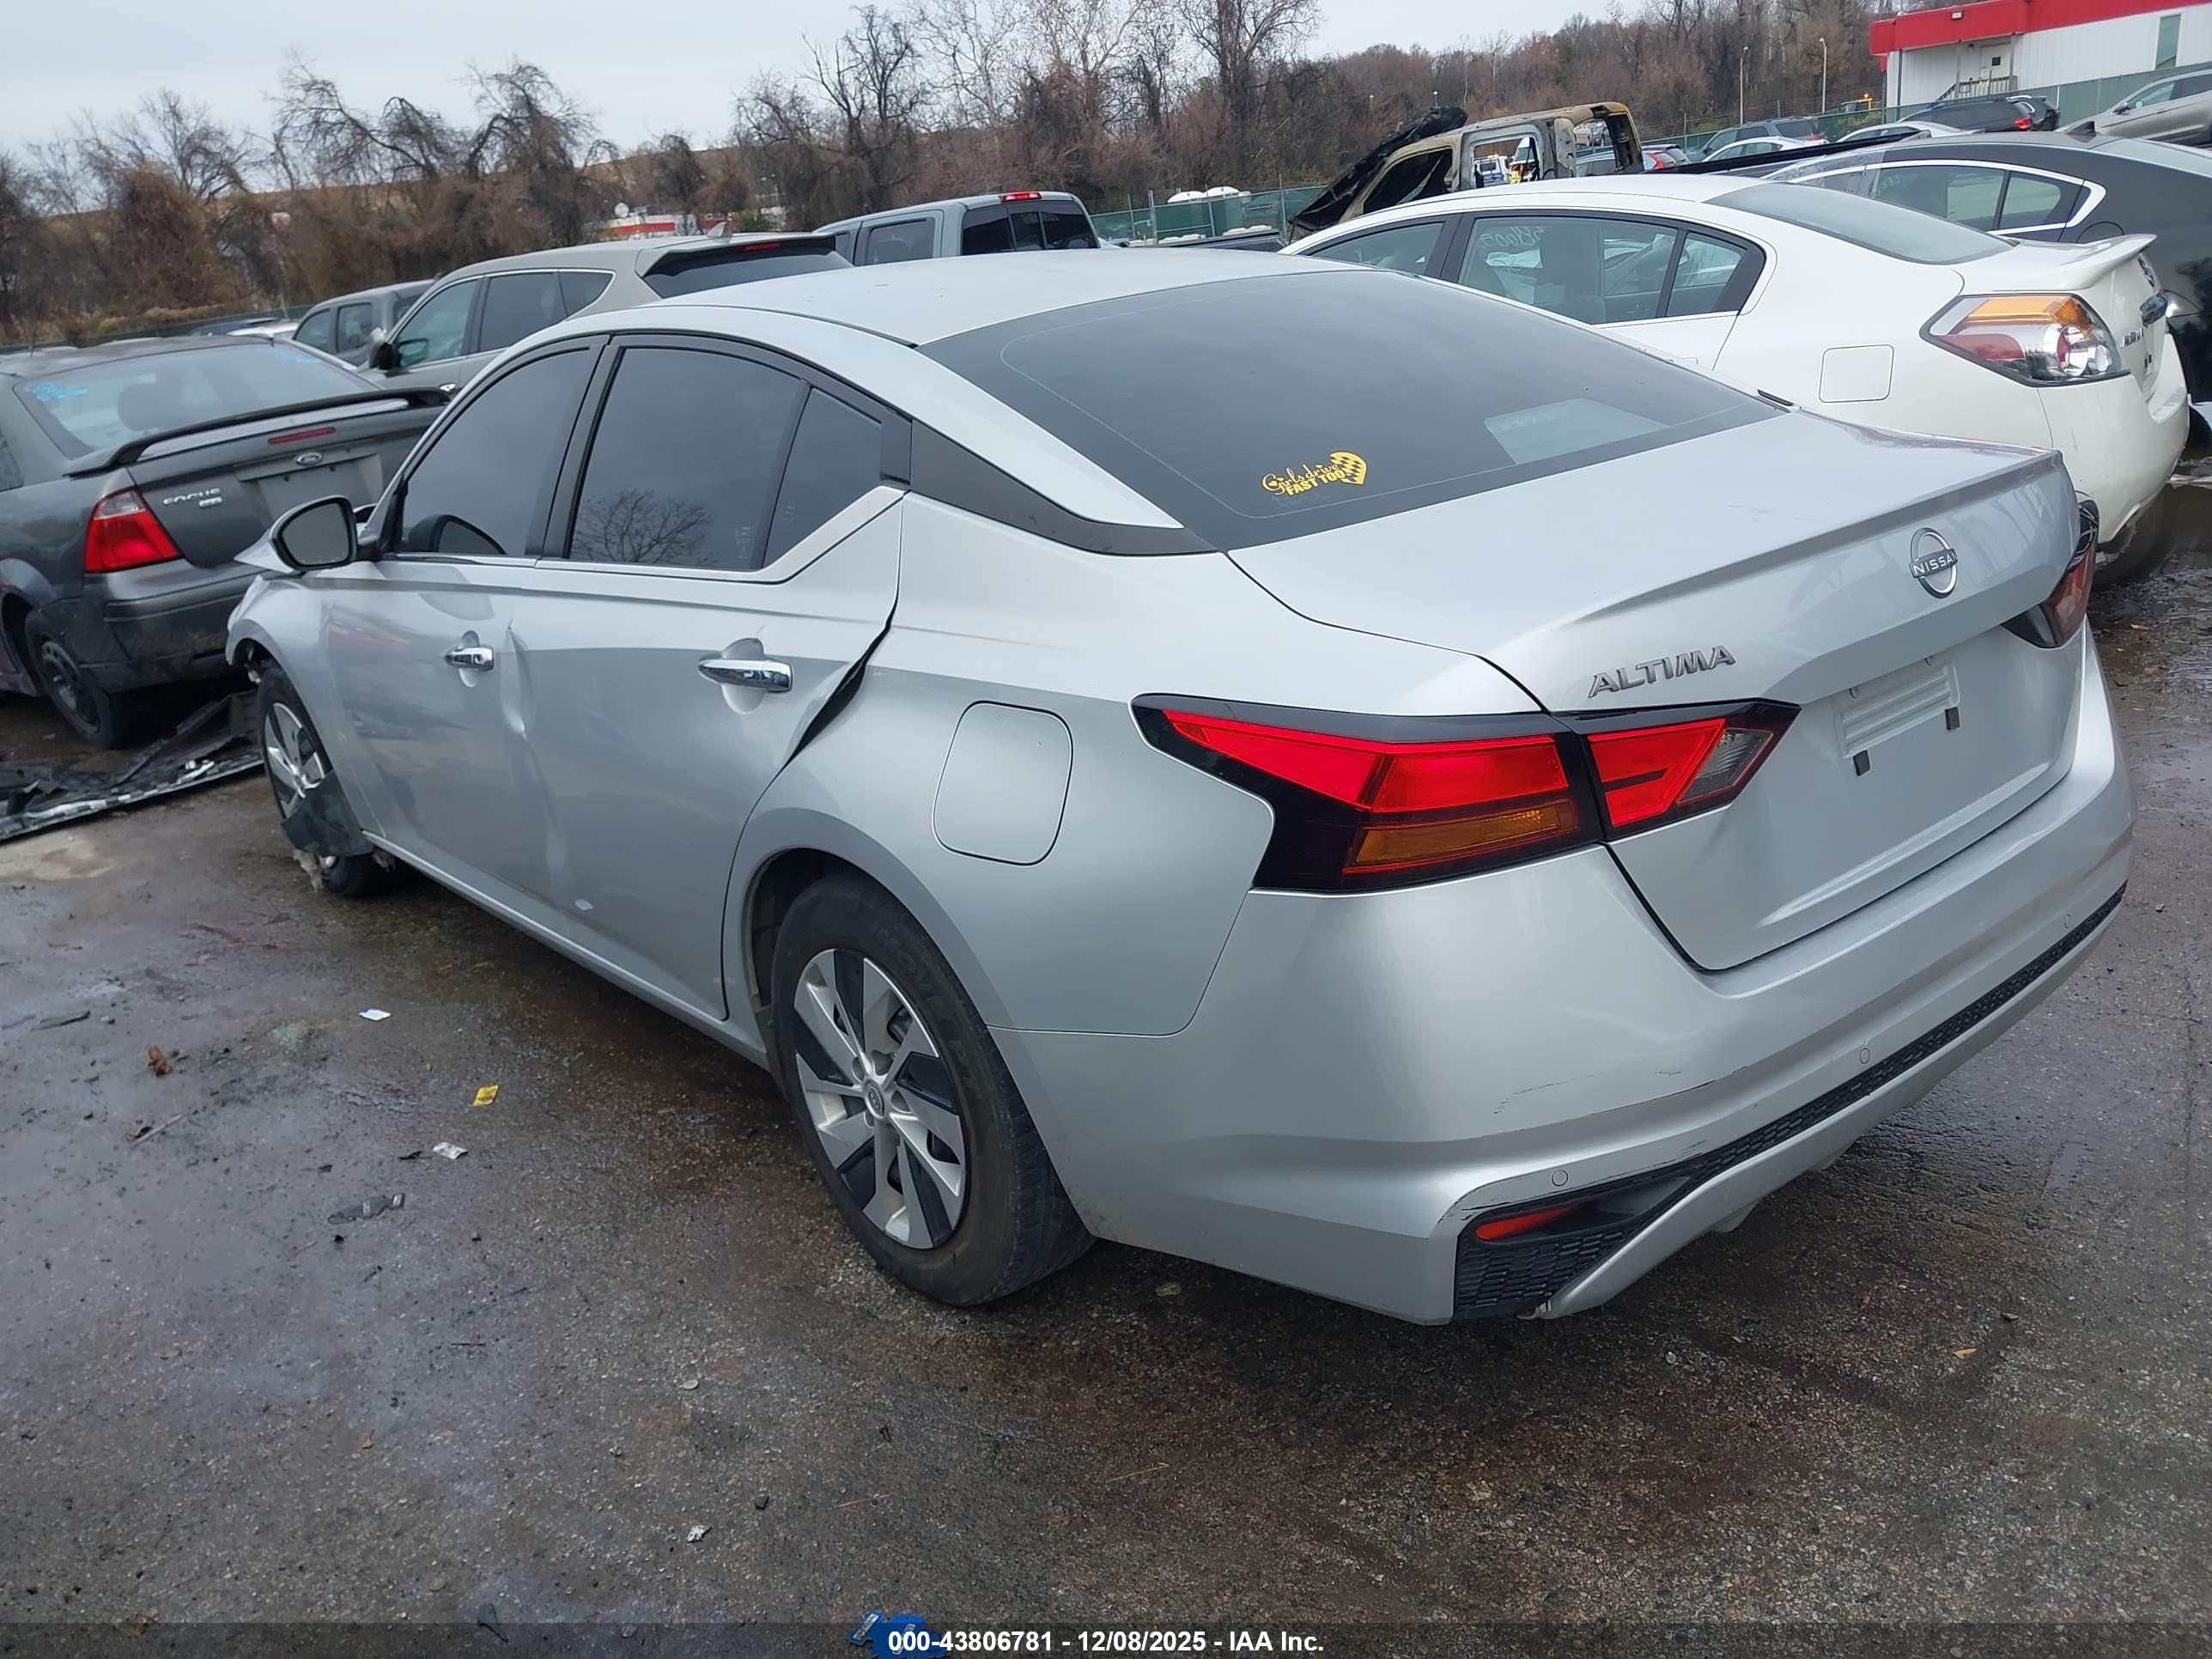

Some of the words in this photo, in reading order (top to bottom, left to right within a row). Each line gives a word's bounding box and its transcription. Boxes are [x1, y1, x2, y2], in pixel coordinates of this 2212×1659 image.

[1262, 467, 1304, 495] Girls
[1302, 464, 1340, 478] drive
[1285, 477, 1319, 495] FAST
[1319, 469, 1346, 484] TOO
[1588, 645, 1736, 699] ALTIMA
